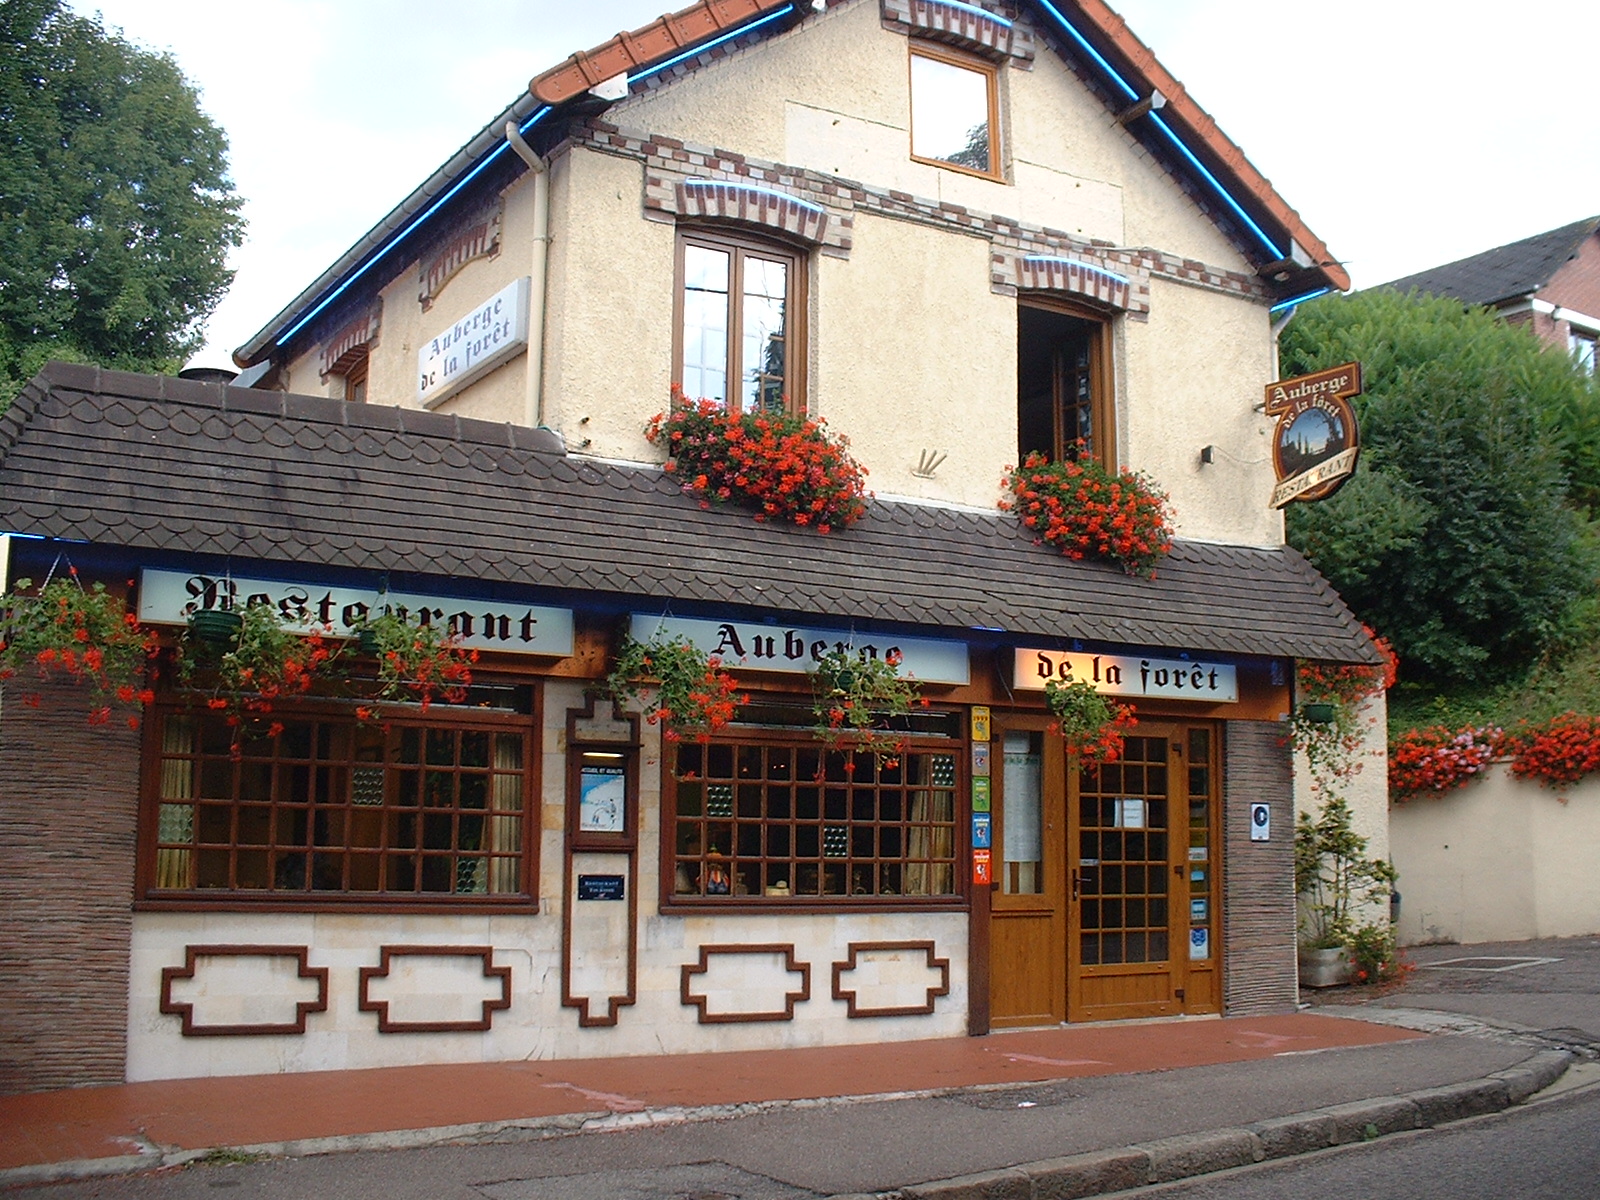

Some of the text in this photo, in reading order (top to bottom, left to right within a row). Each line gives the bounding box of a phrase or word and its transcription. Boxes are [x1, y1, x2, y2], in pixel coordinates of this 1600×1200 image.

[429, 297, 503, 361] Auberge
[421, 317, 511, 391] de la forêt
[1270, 375, 1349, 409] Auberge
[1282, 412, 1295, 429] de
[1295, 401, 1309, 413] la
[1036, 650, 1219, 695] de la forêt
